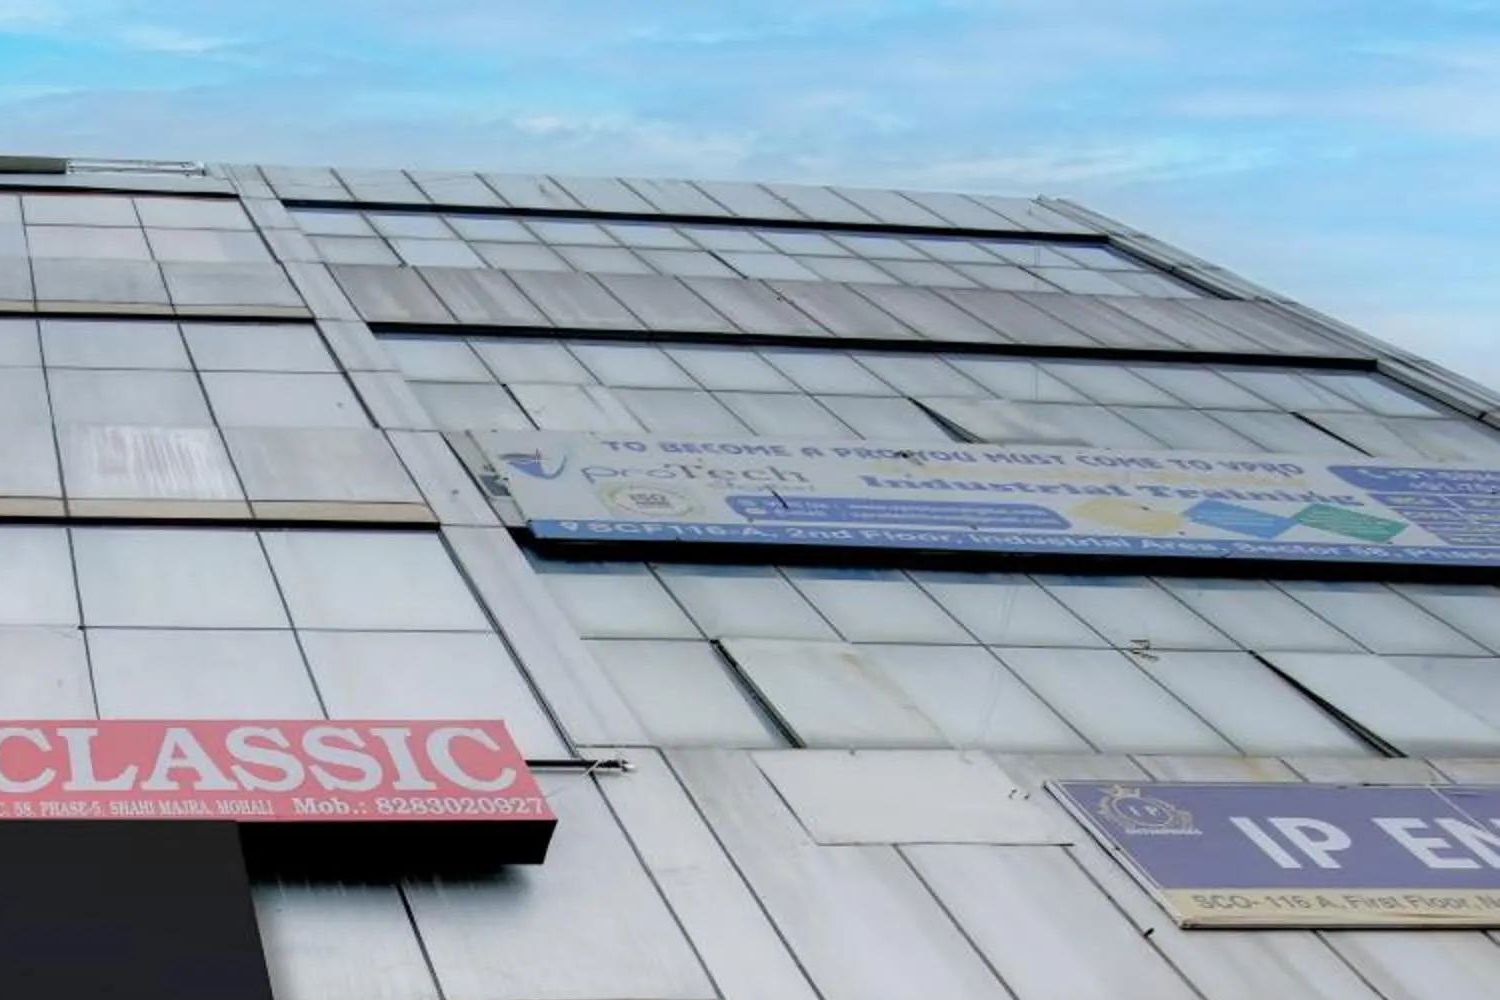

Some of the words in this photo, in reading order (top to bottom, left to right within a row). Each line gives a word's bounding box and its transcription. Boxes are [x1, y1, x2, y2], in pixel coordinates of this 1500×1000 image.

[601, 440, 647, 452] TO
[657, 441, 793, 458] BECOME
[985, 452, 1067, 467] MUST
[1075, 454, 1164, 471] COME
[1166, 459, 1213, 473] TO
[860, 475, 1129, 498] Industrial
[1135, 484, 1366, 507] Training
[785, 527, 852, 541] 2nd
[964, 531, 1131, 550] Industrial
[1231, 541, 1340, 557] Sector
[376, 798, 545, 817] 8283020927
[1228, 816, 1352, 869] IP
[1267, 895, 1312, 910] 116
[1347, 894, 1400, 911] First
